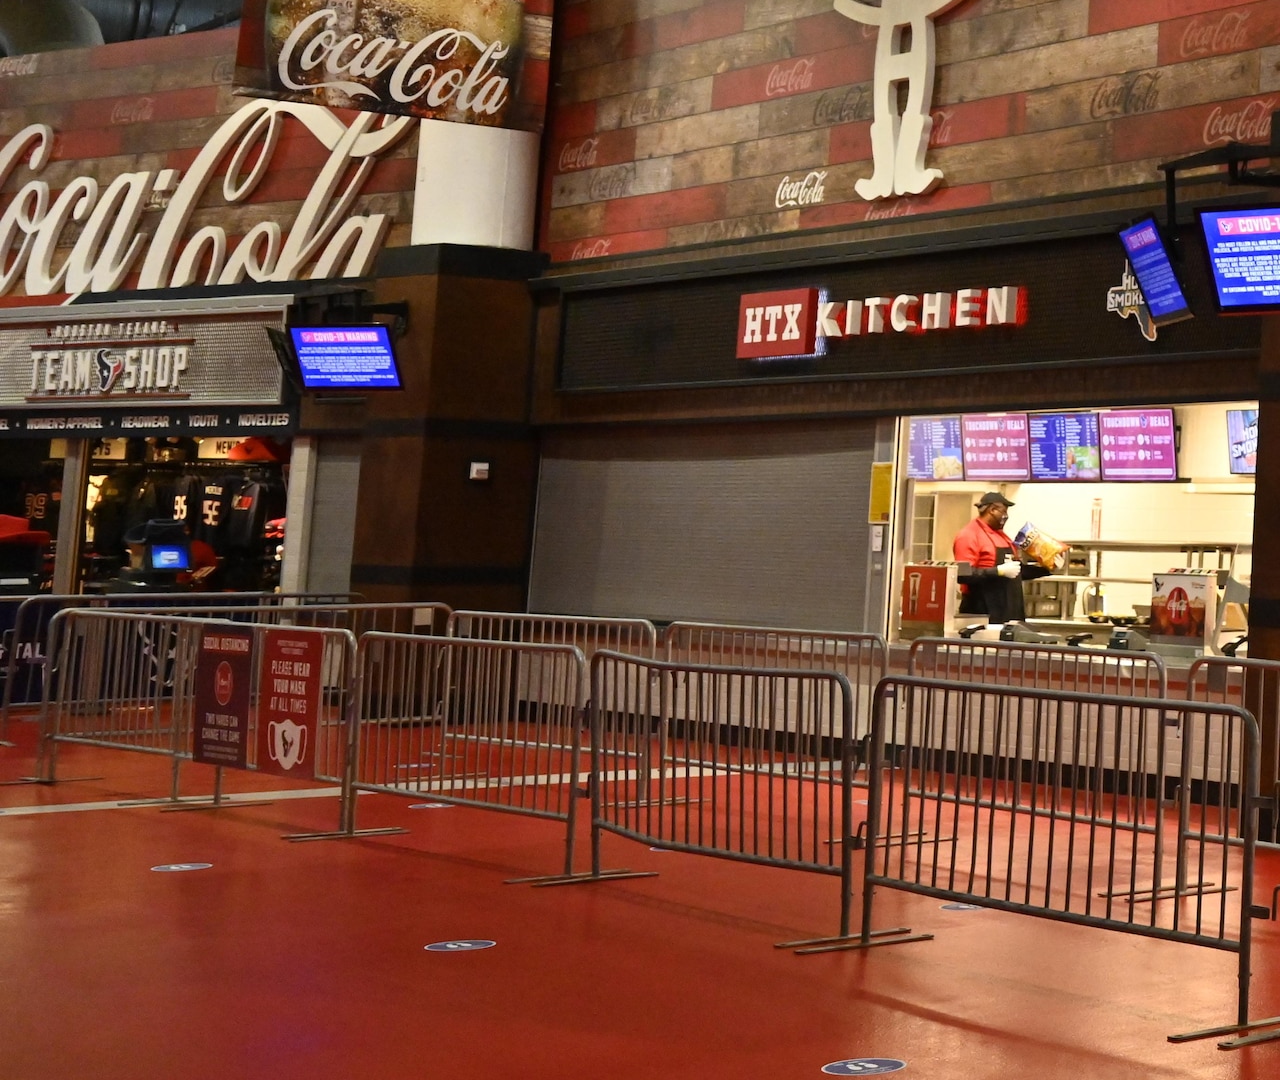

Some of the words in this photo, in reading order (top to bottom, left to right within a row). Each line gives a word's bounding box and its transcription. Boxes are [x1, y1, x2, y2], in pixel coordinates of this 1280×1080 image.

[277, 8, 509, 116] Coca-Cola
[766, 57, 816, 96] Coca-Cola
[775, 170, 829, 209] Coca-Cola
[743, 304, 802, 344] HTX
[816, 285, 1017, 338] KITCHEN
[31, 350, 92, 392] TEAM
[124, 347, 189, 389] SHOP
[121, 416, 170, 428] HEADWEAR
[188, 413, 218, 427] YOUTH
[238, 413, 289, 426] NOVELTIES
[1103, 416, 1140, 428] TOUCHDOWN
[271, 660, 292, 675] PLEASE
[293, 662, 311, 677] WEAR
[273, 678, 289, 694] YOUR
[290, 680, 306, 695] MASK
[270, 696, 278, 710] AT
[278, 697, 288, 712] ALL
[290, 698, 307, 714] TIMES
